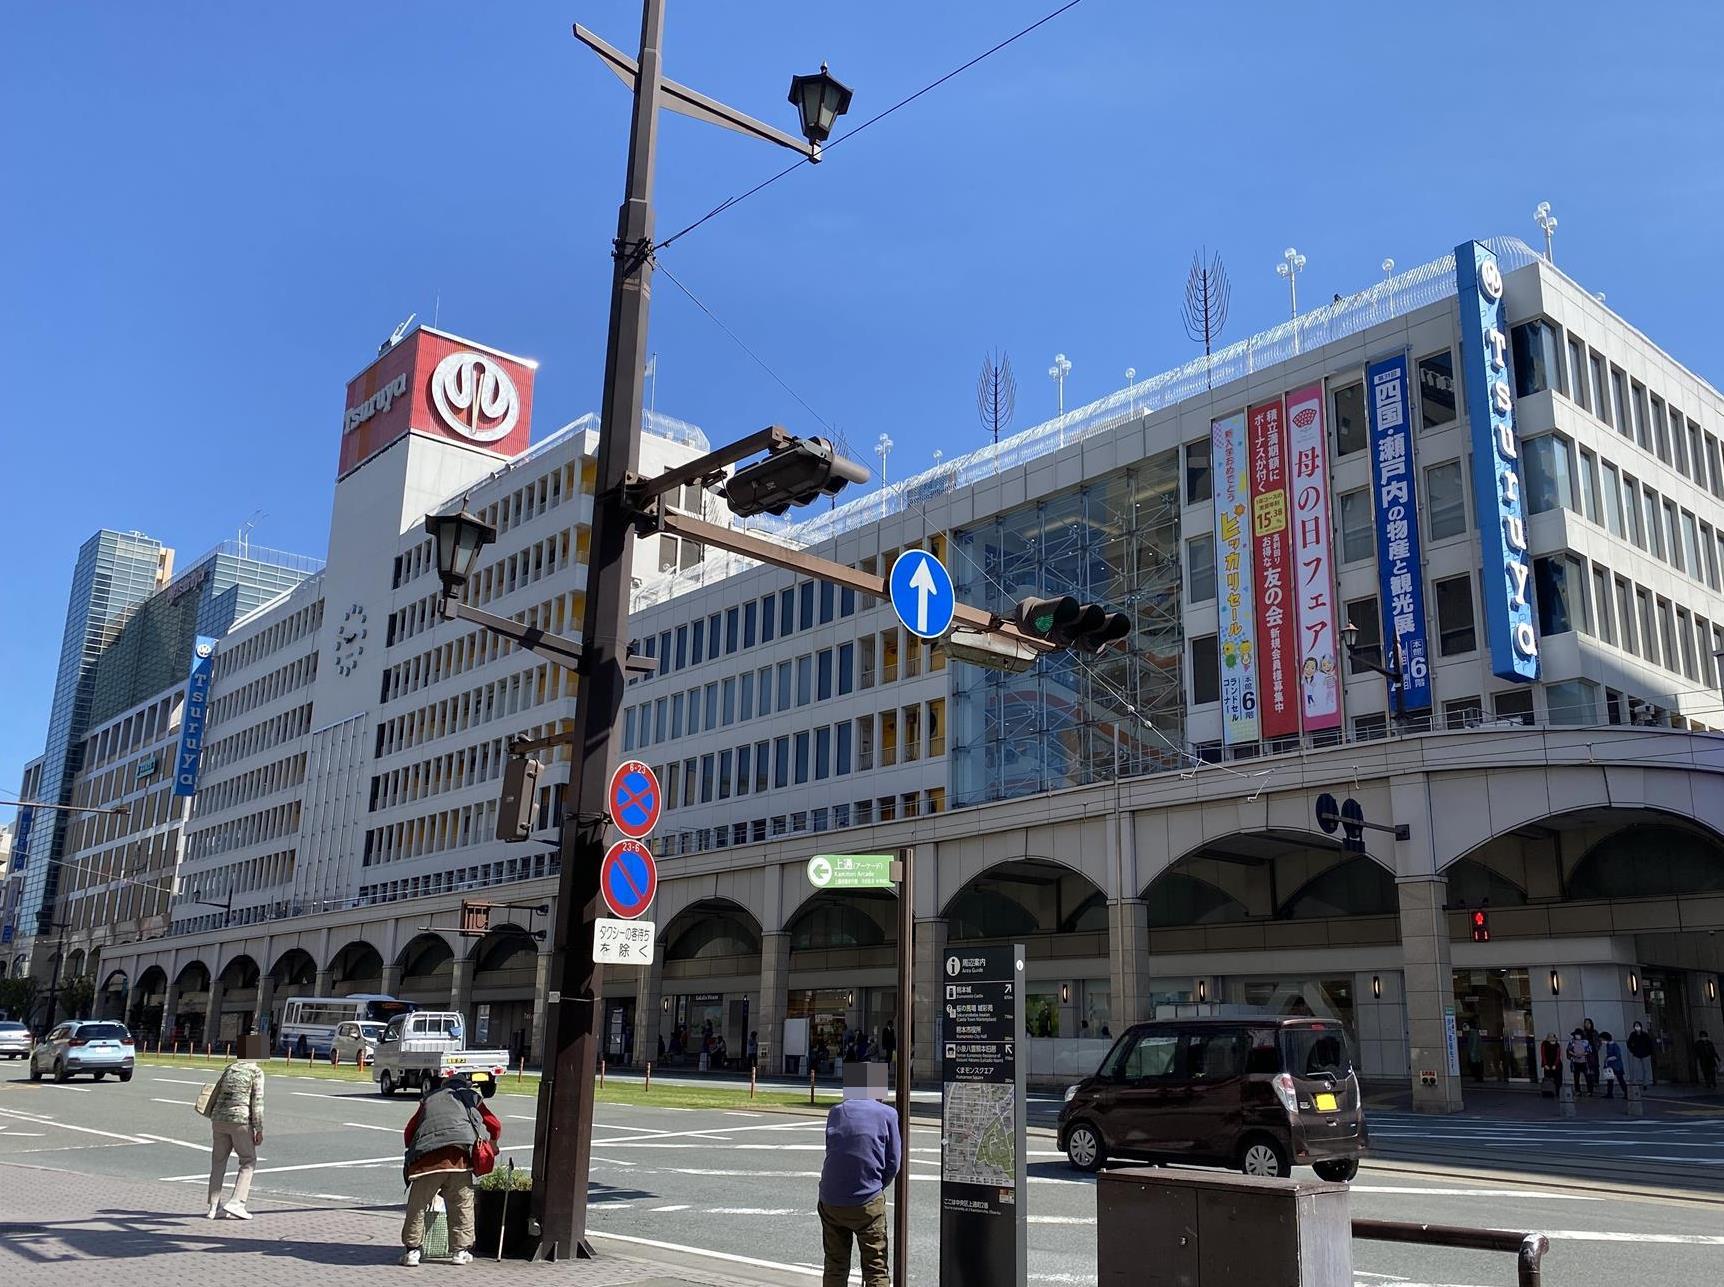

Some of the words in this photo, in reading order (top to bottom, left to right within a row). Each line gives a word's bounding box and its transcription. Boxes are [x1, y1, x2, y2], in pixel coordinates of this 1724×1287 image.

[1375, 378, 1416, 635] 四国・瀬戸内の物産と観光展
[1484, 328, 1538, 661] Tsuruya
[1220, 503, 1246, 638] ピッカリセール
[1262, 536, 1272, 567] お得な
[1295, 446, 1328, 654] 母の日フェア
[1263, 567, 1284, 628] 友の会
[1223, 679, 1231, 714] コーナー
[1229, 678, 1239, 722] ランドセル
[179, 673, 207, 785] Tsuruya
[622, 842, 640, 853] 23-6
[600, 925, 650, 943] タクシーの客待ち
[956, 1066, 994, 1075] くまモンスクエア
